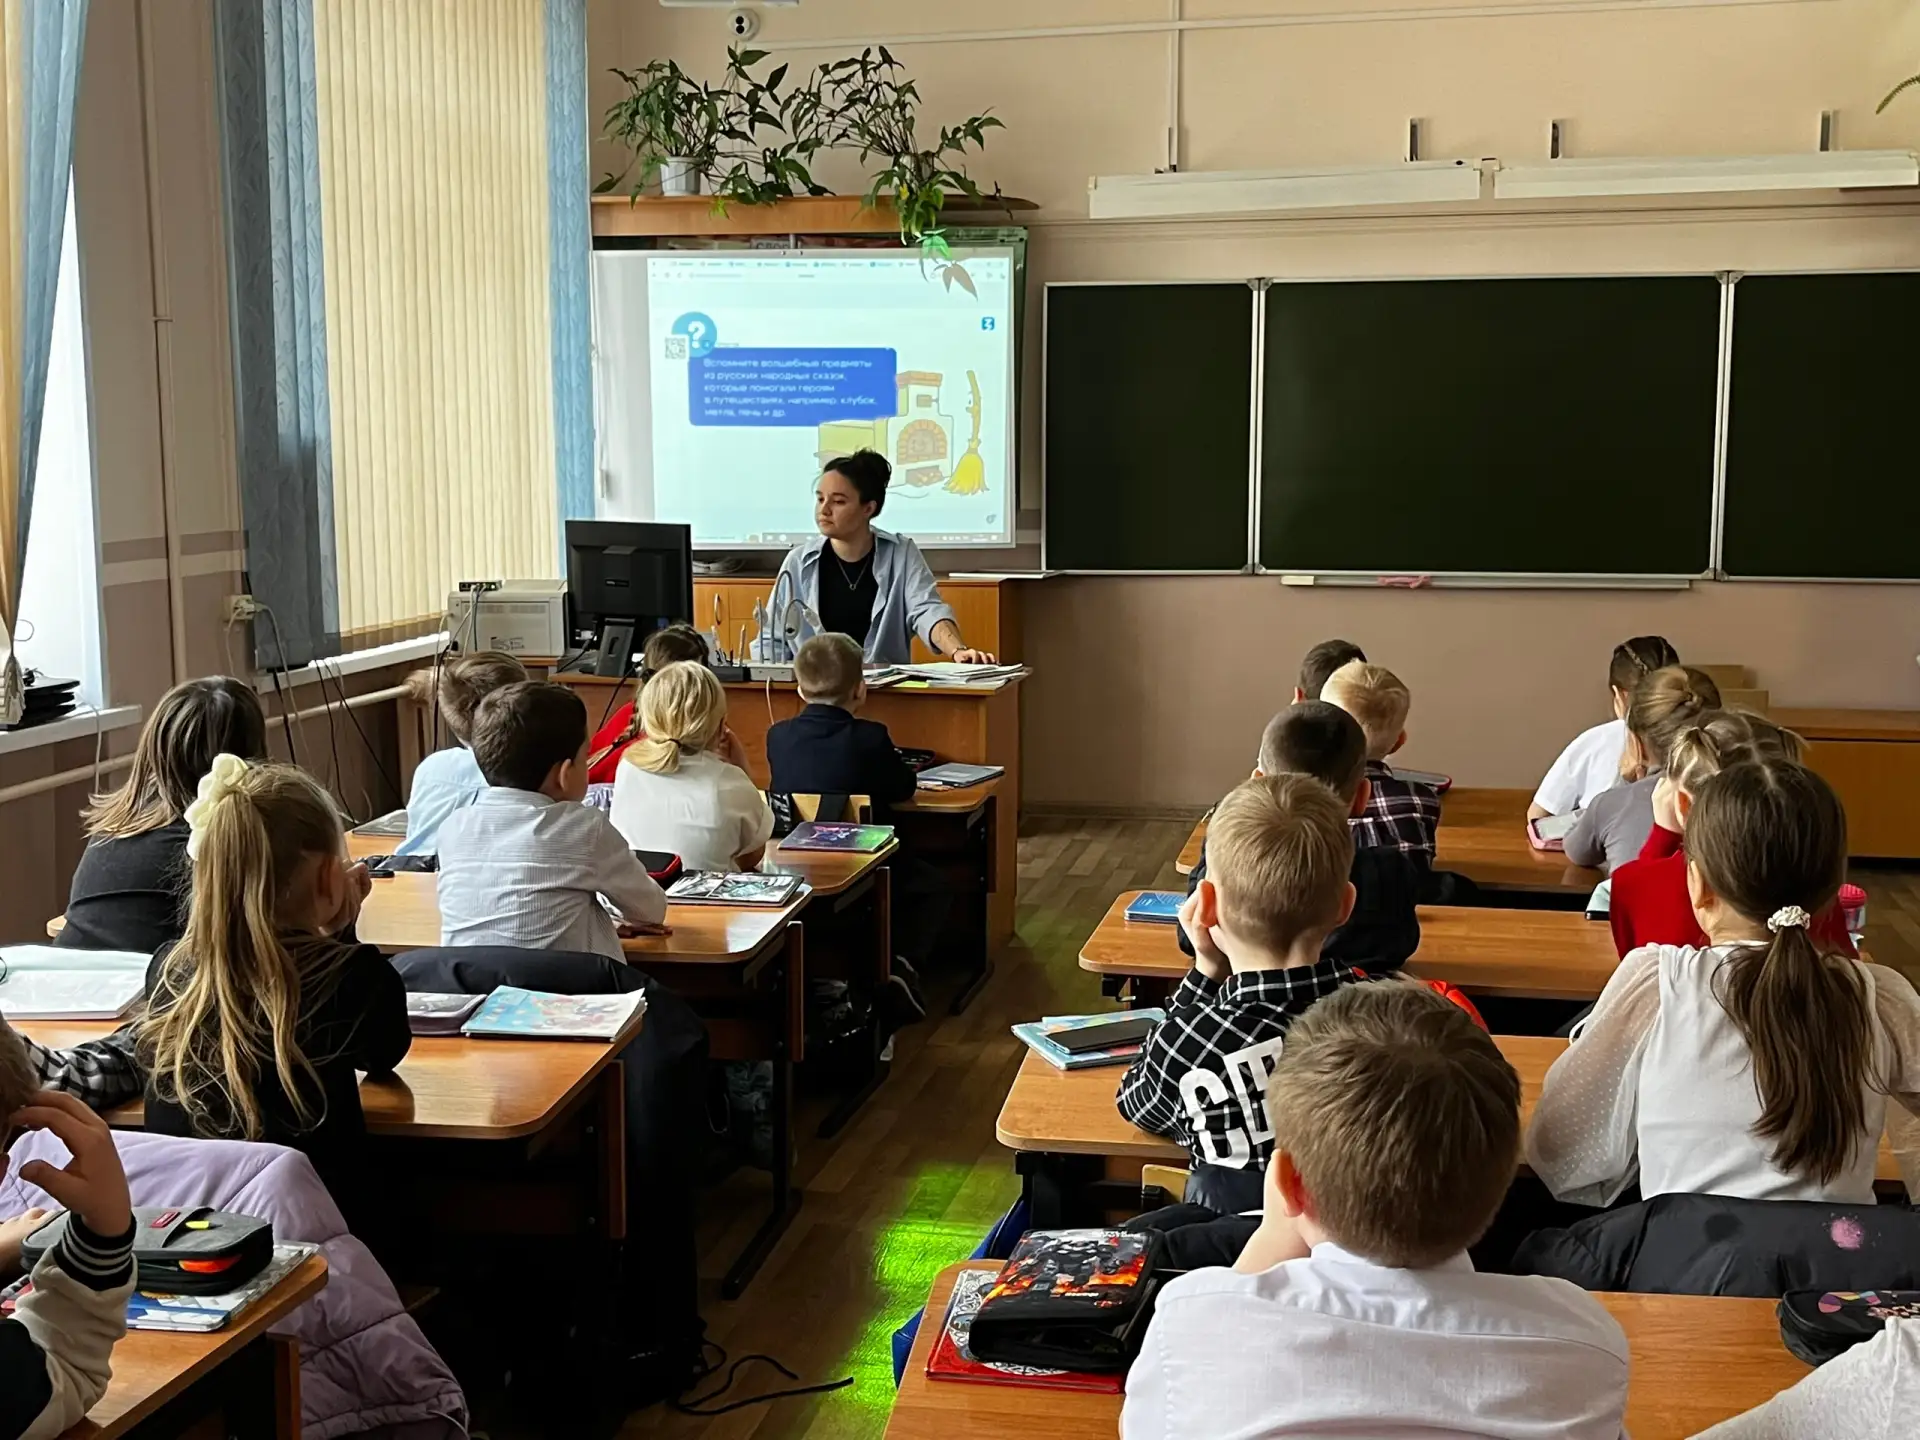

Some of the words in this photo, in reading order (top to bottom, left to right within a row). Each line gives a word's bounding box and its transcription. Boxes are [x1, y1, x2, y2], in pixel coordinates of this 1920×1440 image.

[703, 358, 759, 368] Вспомните
[761, 358, 819, 368] волшебные
[821, 359, 872, 369] предметы
[704, 372, 715, 380] из
[717, 372, 758, 381] русских
[761, 372, 810, 381] народных
[704, 384, 747, 394] которые
[749, 384, 796, 392] помогали
[798, 384, 835, 394] героям
